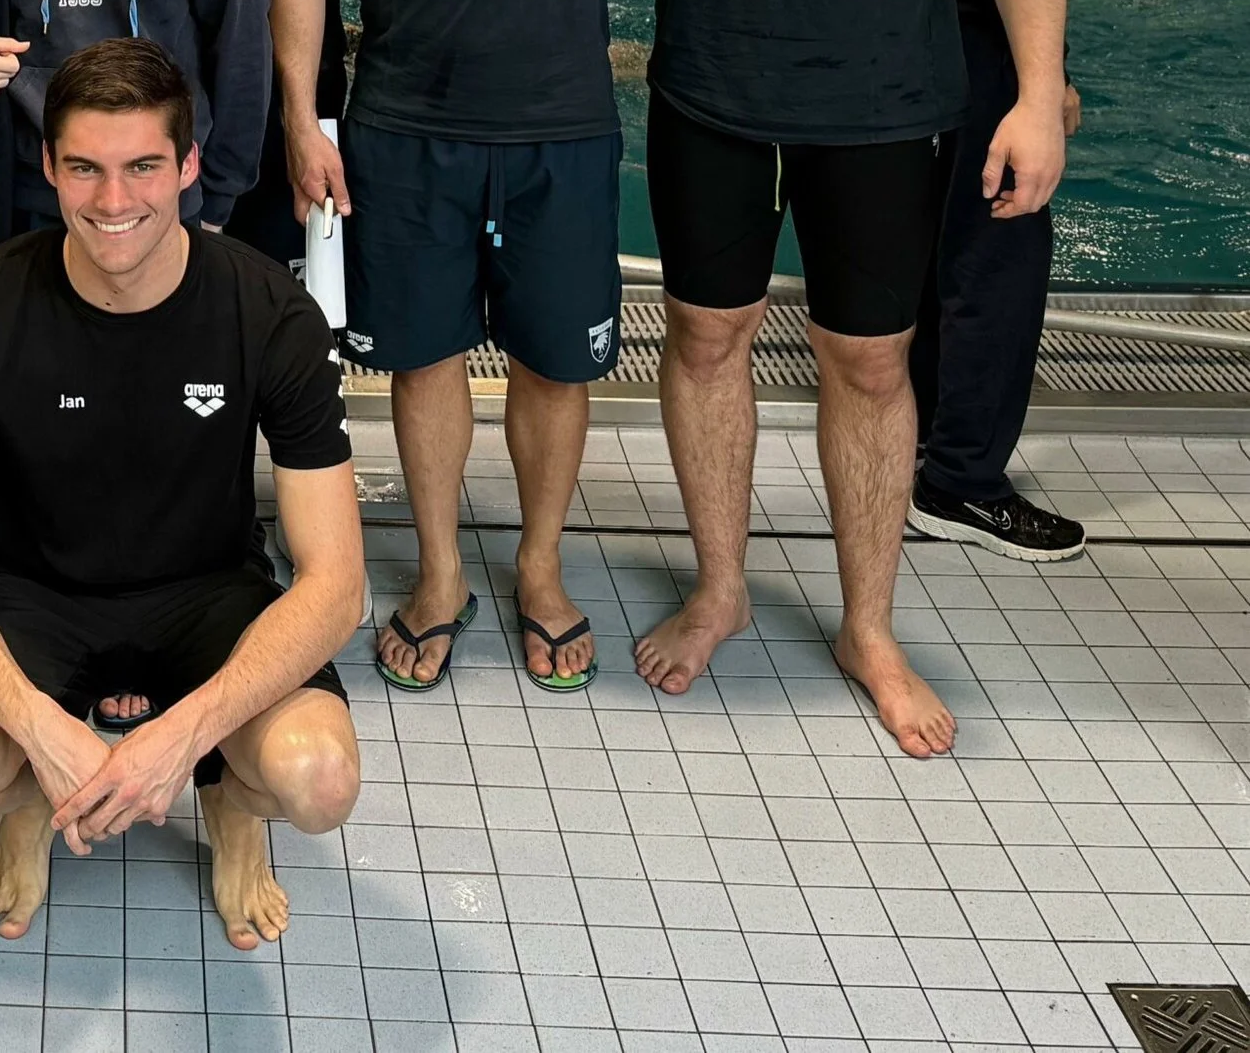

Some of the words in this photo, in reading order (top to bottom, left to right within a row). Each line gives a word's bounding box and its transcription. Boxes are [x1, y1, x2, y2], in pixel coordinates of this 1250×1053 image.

[347, 330, 373, 345] arena
[184, 383, 224, 397] arena
[59, 394, 85, 408] Jan
